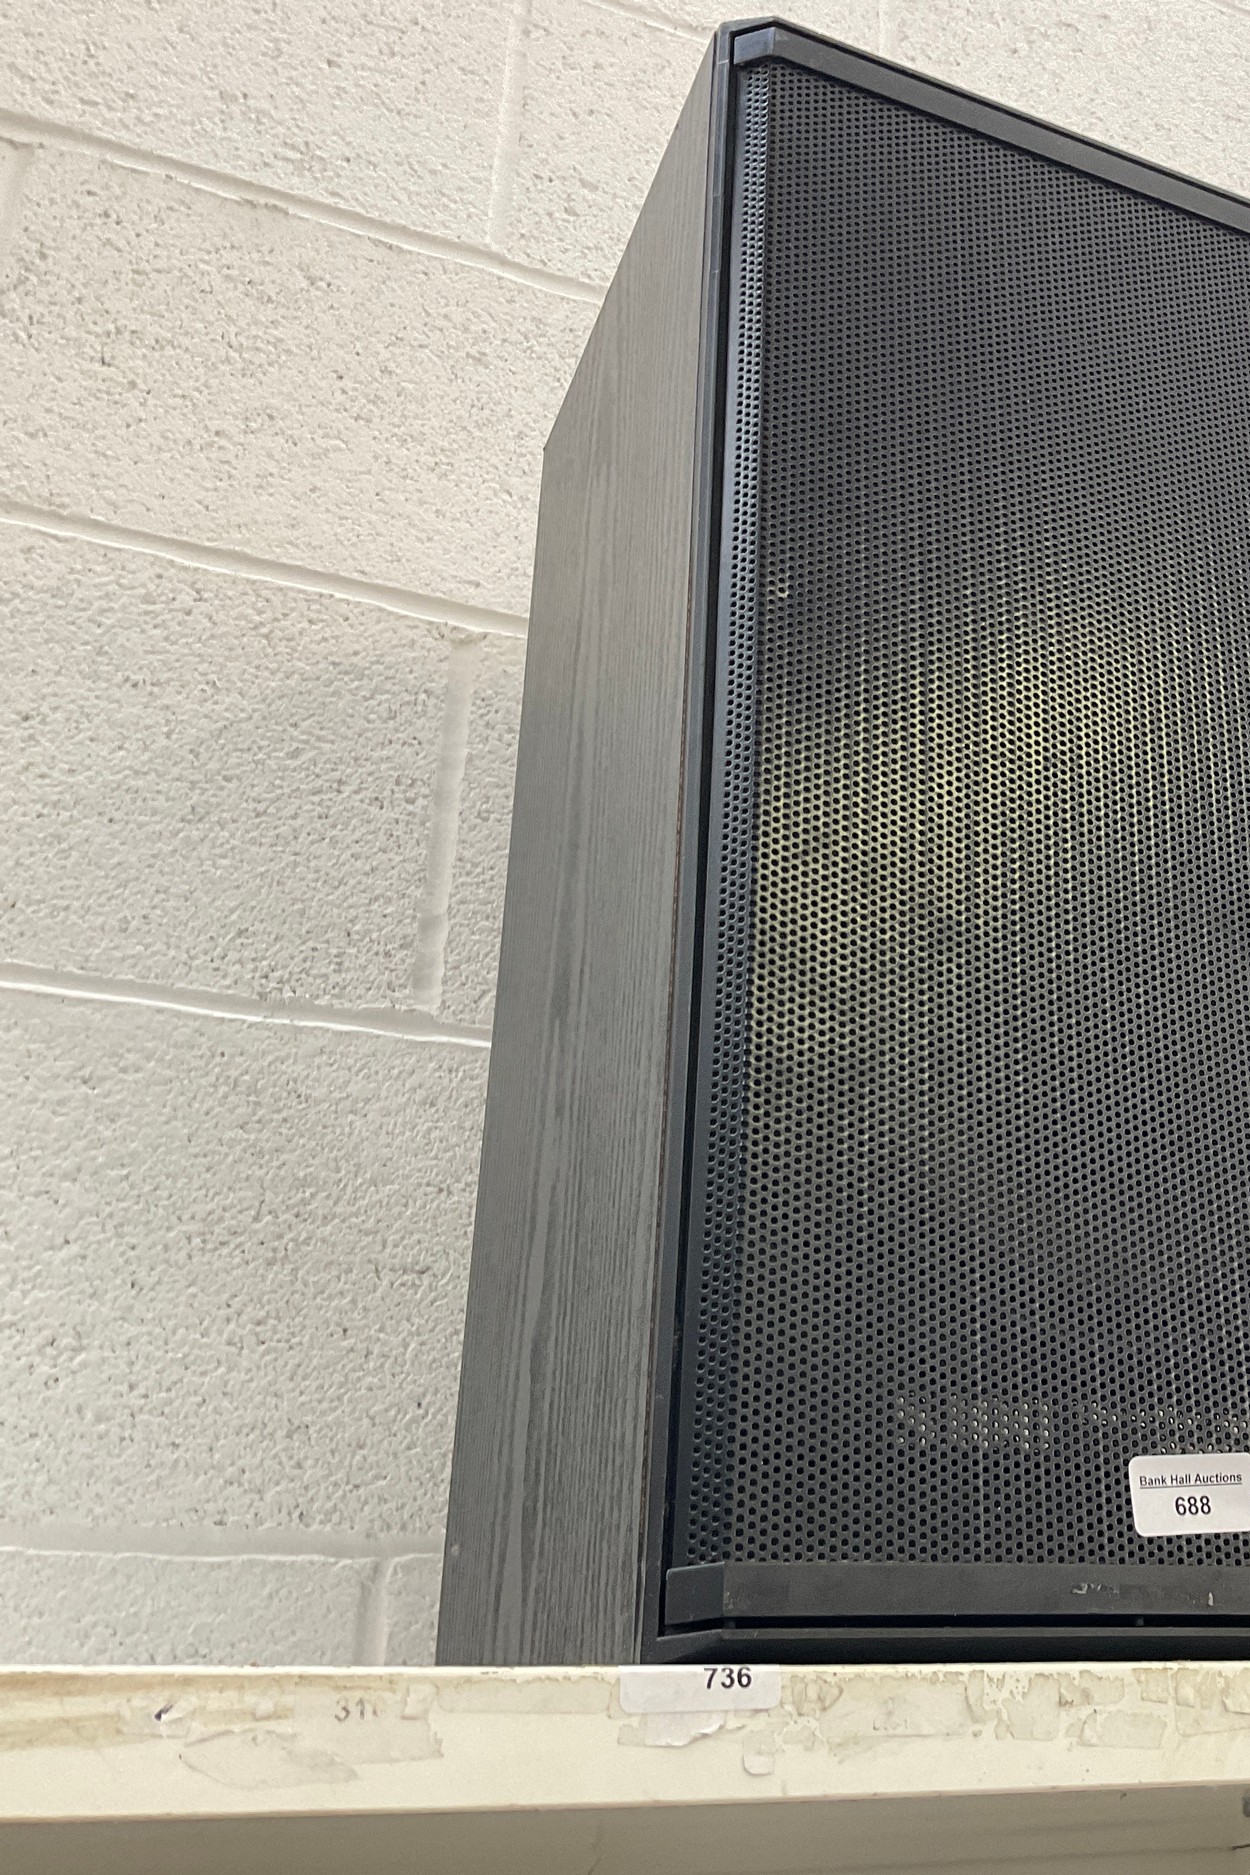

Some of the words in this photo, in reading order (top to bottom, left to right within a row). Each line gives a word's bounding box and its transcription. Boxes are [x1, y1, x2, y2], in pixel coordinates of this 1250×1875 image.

[1139, 1474, 1168, 1487] Bank
[1170, 1474, 1191, 1485] Hall
[1194, 1472, 1243, 1485] Auctions
[1175, 1495, 1212, 1516] 688
[703, 1666, 753, 1690] 736
